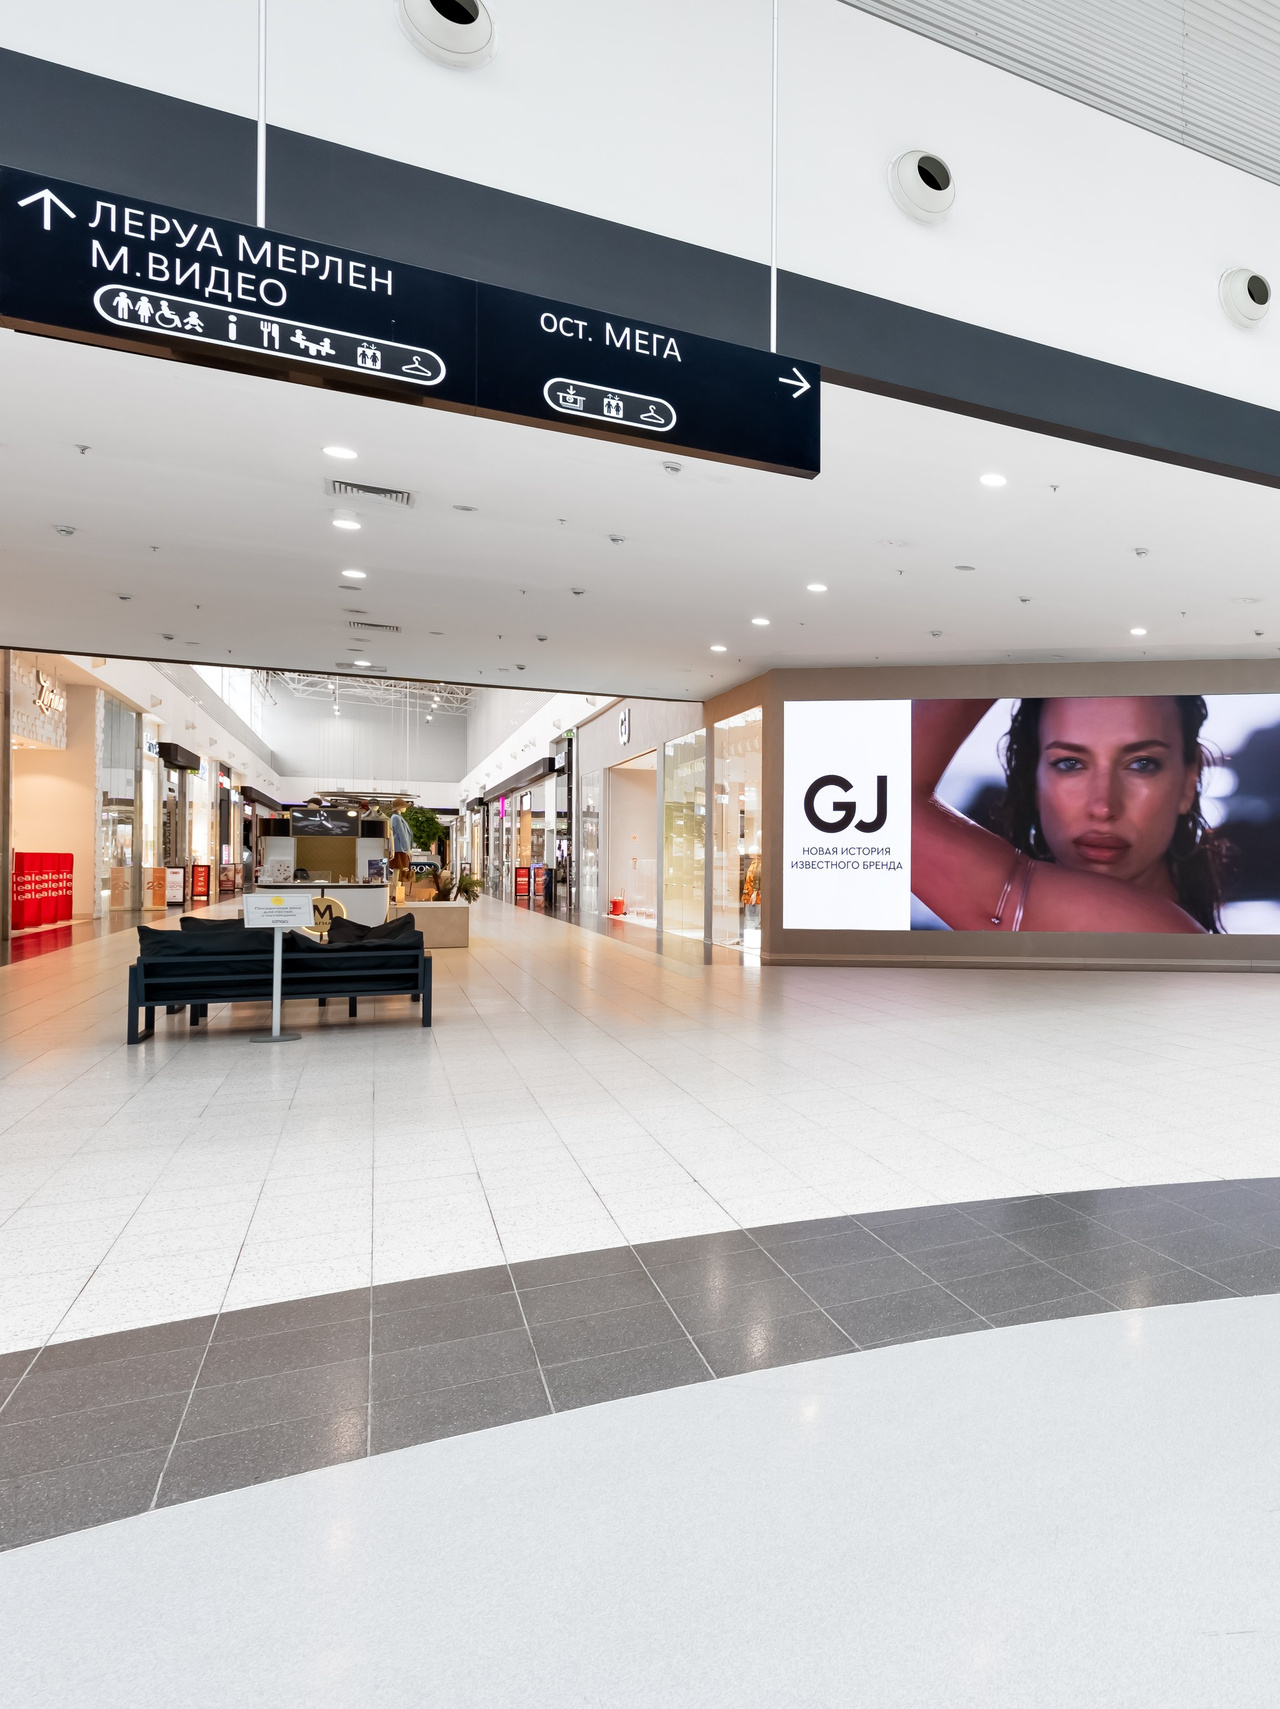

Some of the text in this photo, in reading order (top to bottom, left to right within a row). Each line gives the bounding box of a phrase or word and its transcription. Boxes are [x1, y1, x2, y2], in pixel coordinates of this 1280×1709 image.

[89, 200, 393, 296] ЛЕРУА МЕРЛЕН
[91, 239, 287, 307] М.ВИДЕО
[605, 322, 682, 363] МЕГА
[803, 774, 887, 833] GJ
[791, 861, 903, 871] ИЗВЕСТНОГО БРЕНДА
[802, 847, 891, 856] НОВАЯ ИСТОРИЯ
